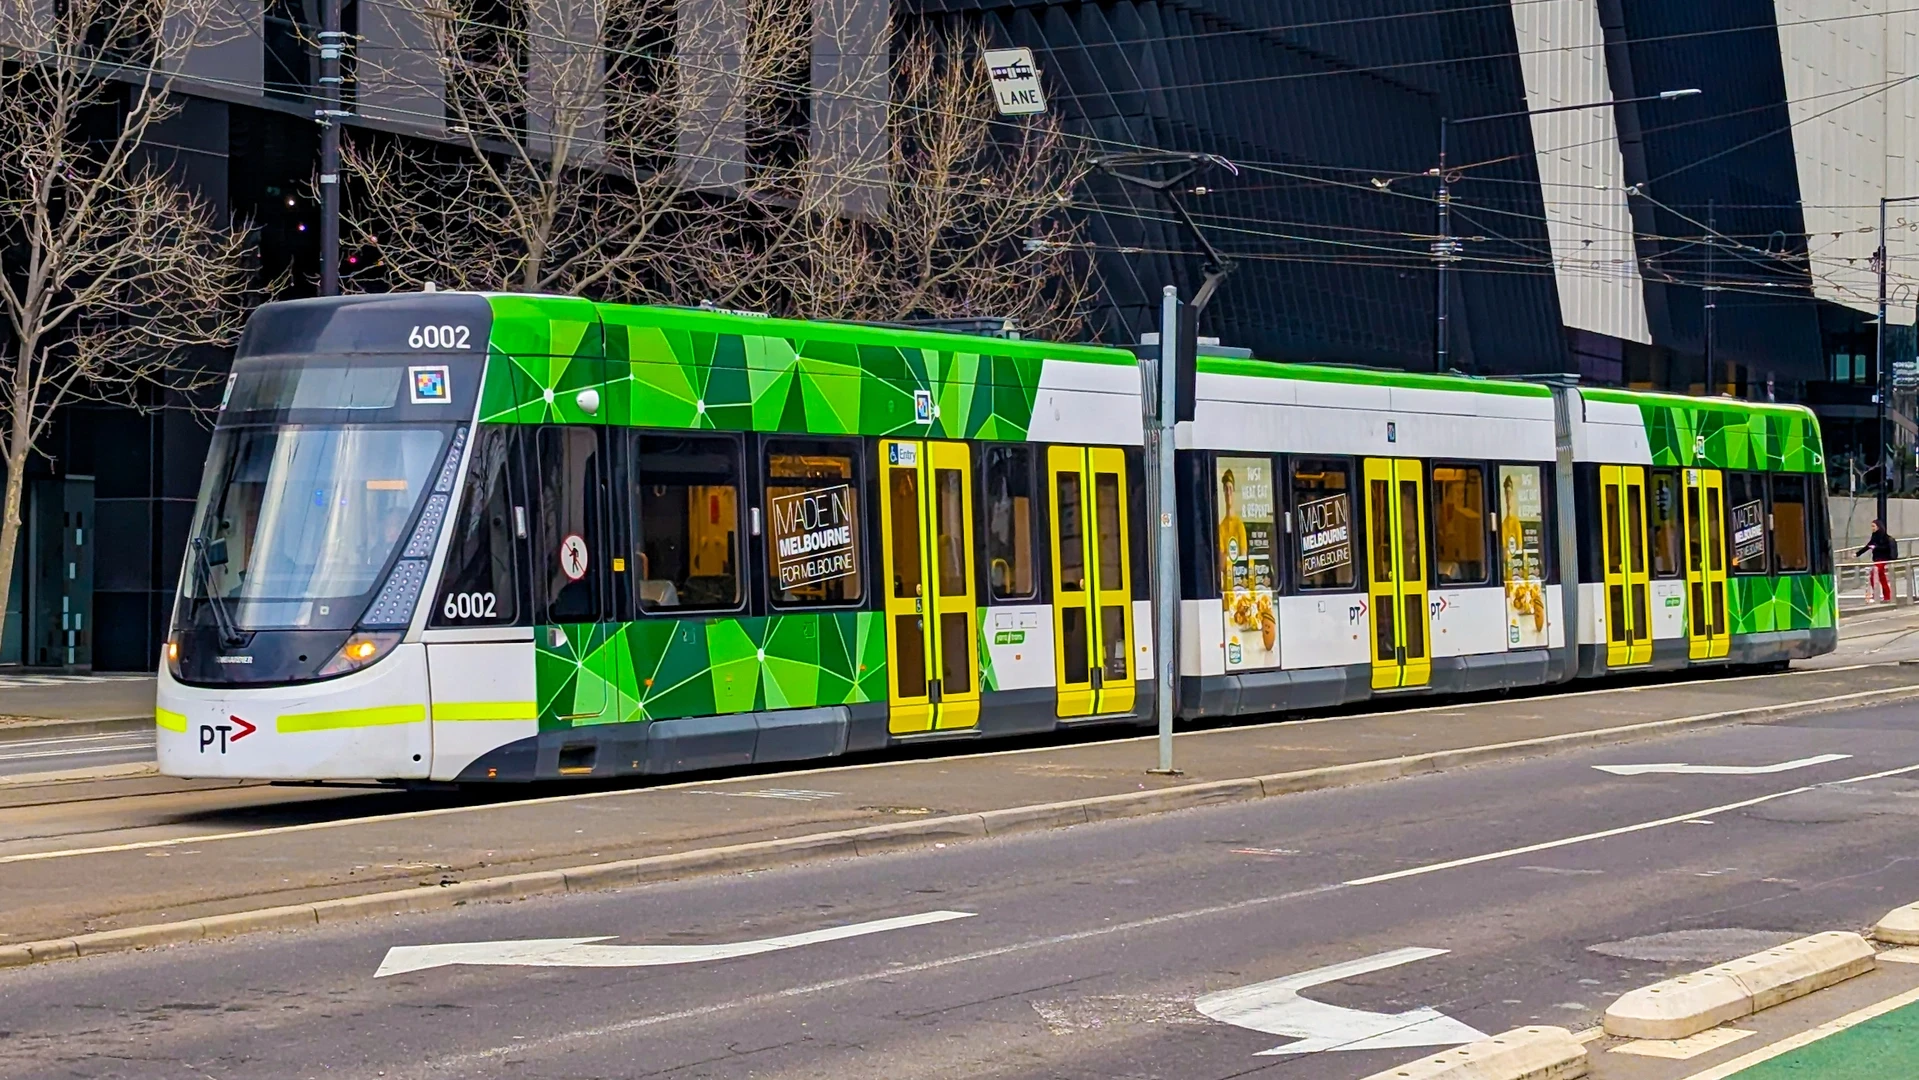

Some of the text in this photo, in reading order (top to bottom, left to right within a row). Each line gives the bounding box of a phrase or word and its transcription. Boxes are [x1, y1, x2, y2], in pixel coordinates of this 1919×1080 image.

[1000, 89, 1039, 106] LANE
[408, 325, 471, 349] 6002
[899, 448, 917, 463] Entry
[775, 490, 849, 536] MADE IN
[1300, 499, 1346, 534] MADE IN
[779, 525, 850, 558] MELBOURNE
[1302, 525, 1348, 552] MELBOURNE
[782, 552, 853, 583] FOR MELBOURNE
[1304, 547, 1349, 571] FOR MELBOURNE
[443, 591, 497, 619] 6002
